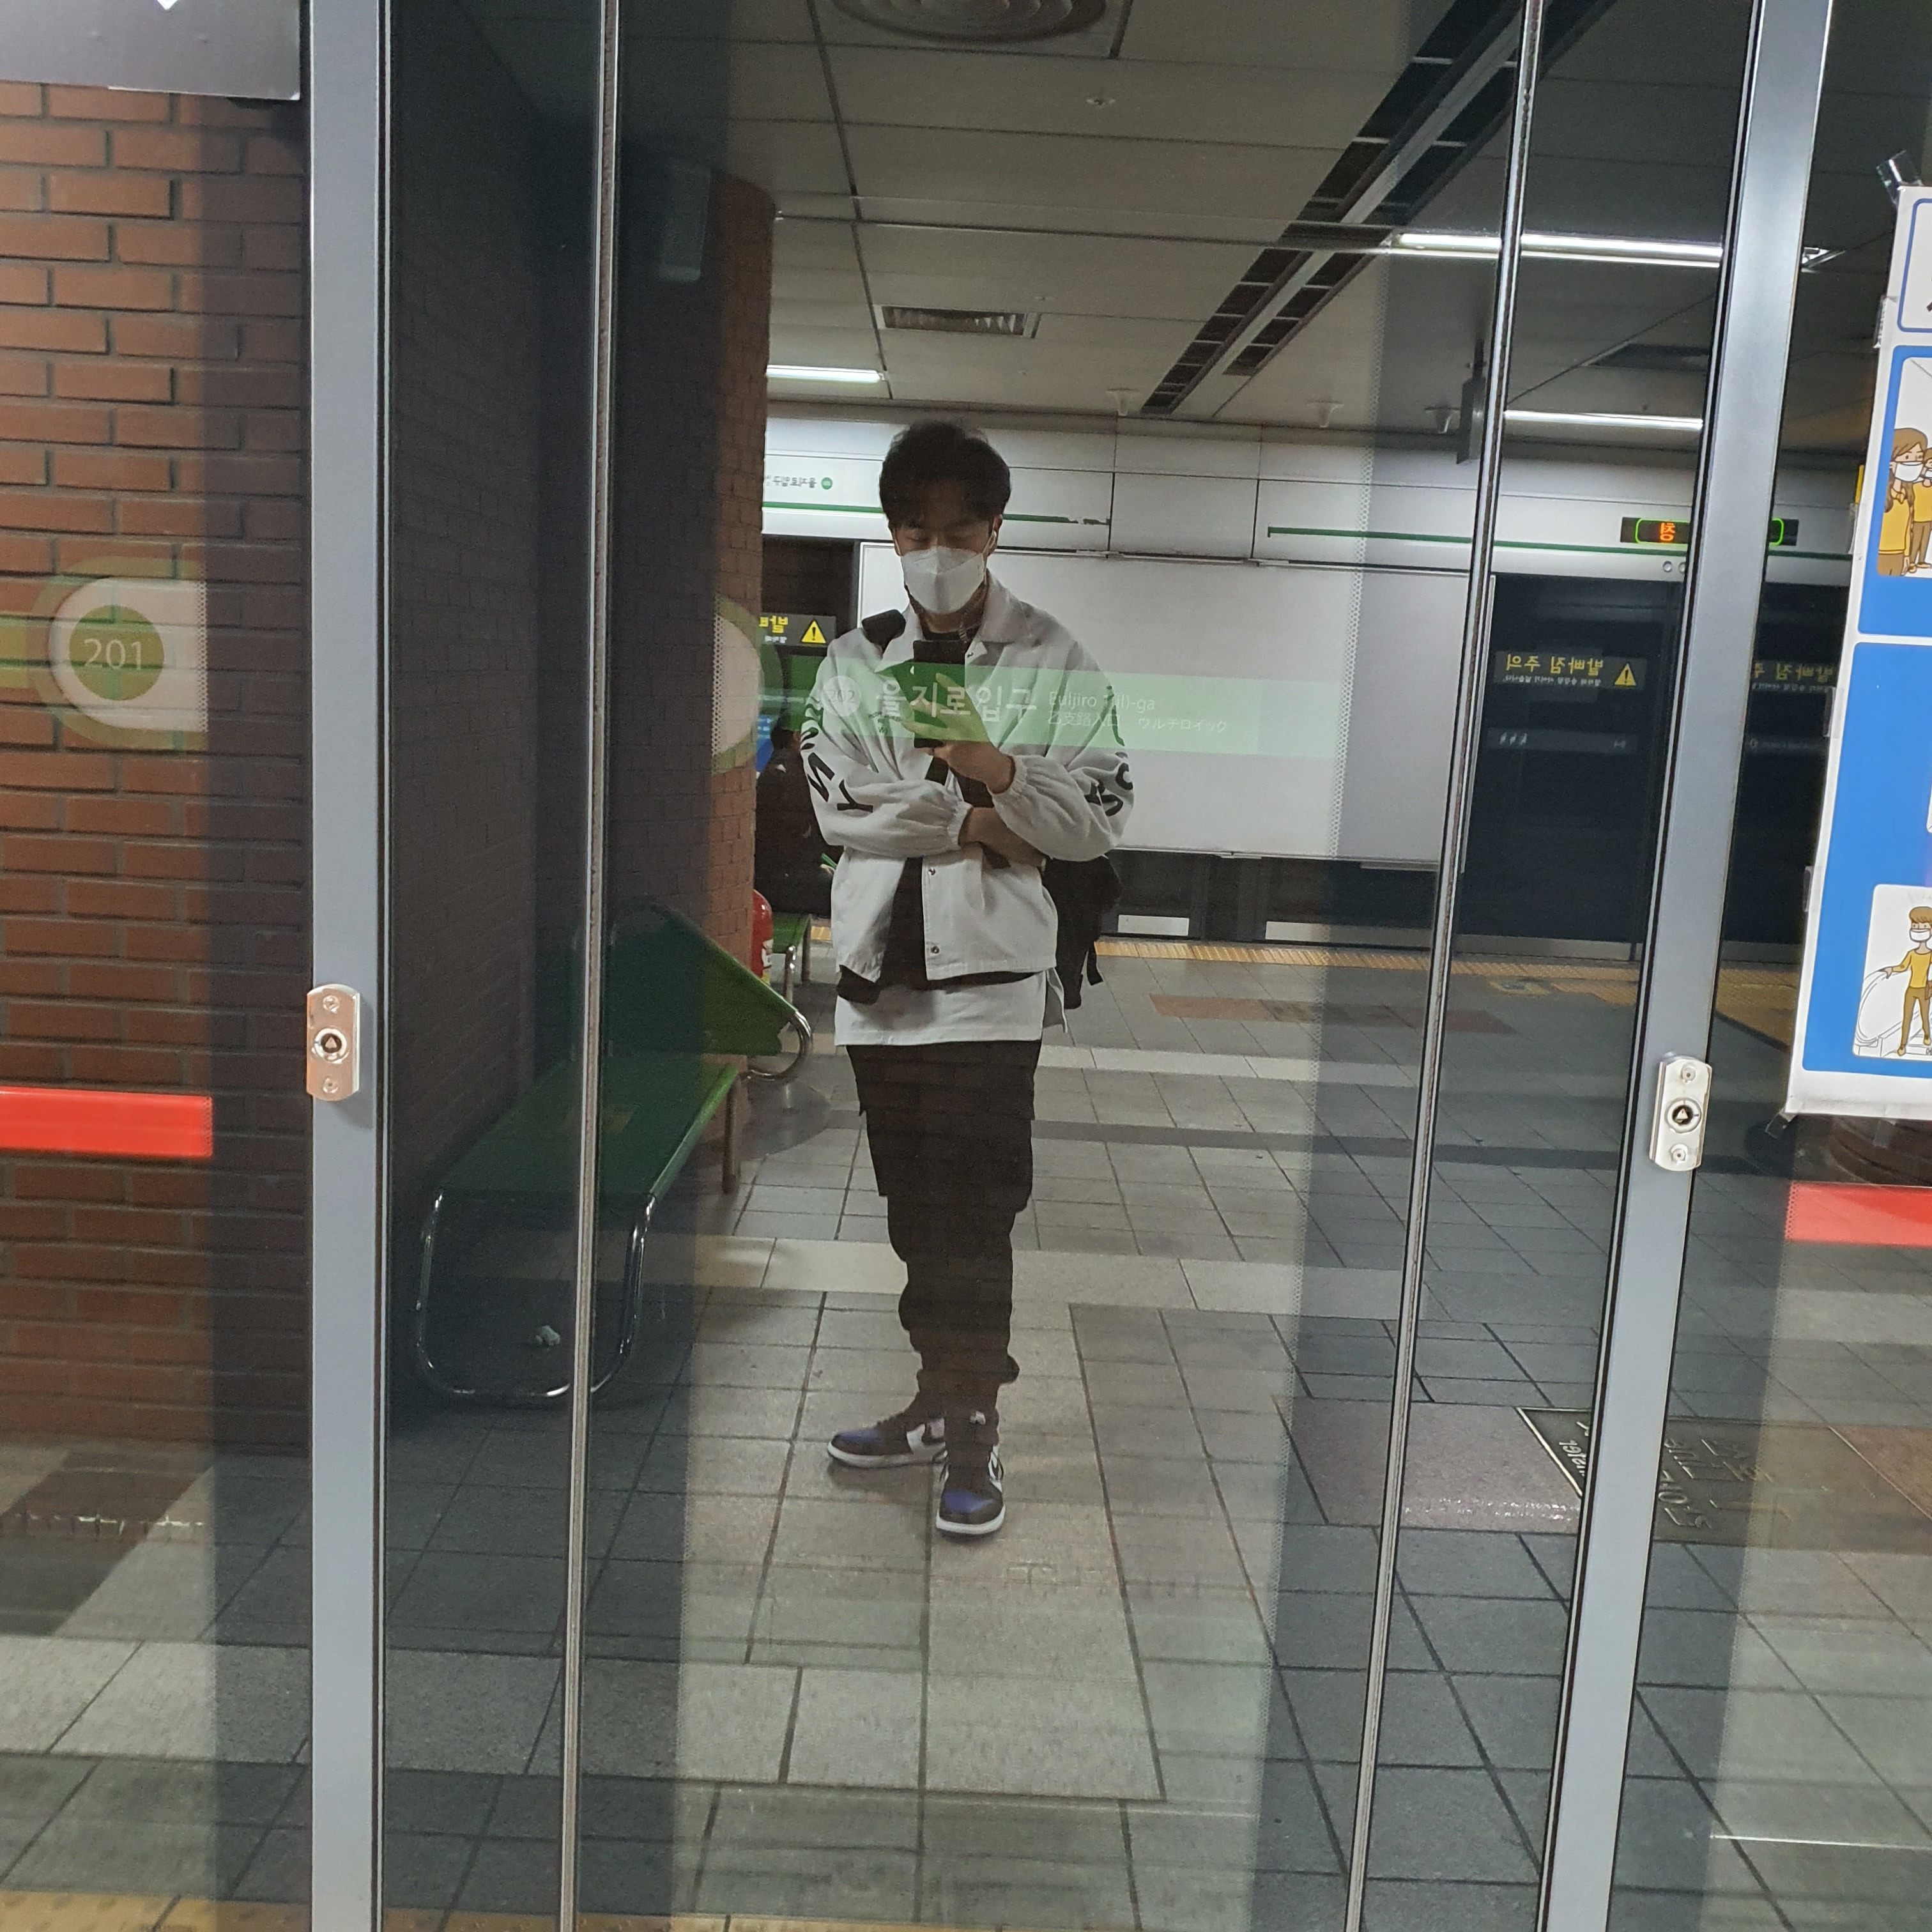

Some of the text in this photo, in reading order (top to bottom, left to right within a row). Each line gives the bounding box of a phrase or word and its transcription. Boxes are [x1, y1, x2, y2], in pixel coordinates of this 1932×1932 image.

[84, 638, 141, 670] 201
[876, 680, 1038, 723] 을지로입구
[1048, 691, 1097, 710] Euljiro
